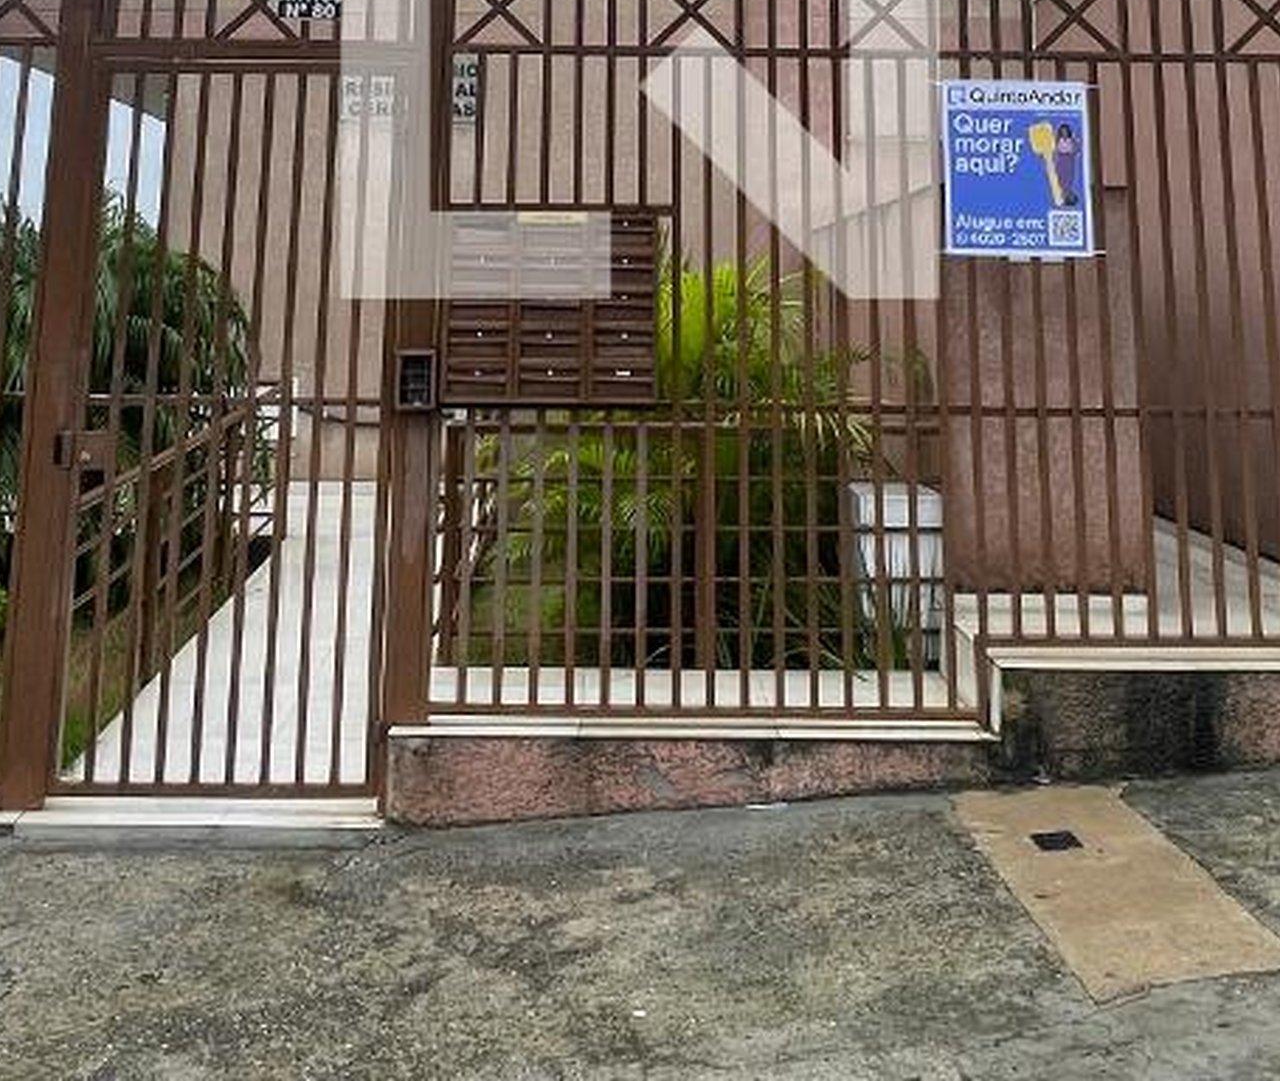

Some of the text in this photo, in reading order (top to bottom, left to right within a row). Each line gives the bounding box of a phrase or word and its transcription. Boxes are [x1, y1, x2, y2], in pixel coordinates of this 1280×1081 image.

[311, 4, 336, 18] 80
[969, 87, 1081, 105] QuintoAndar
[953, 113, 1013, 134] Quer
[954, 137, 1023, 153] morar
[955, 155, 1019, 177] aqui?
[955, 214, 1013, 232] Alugue
